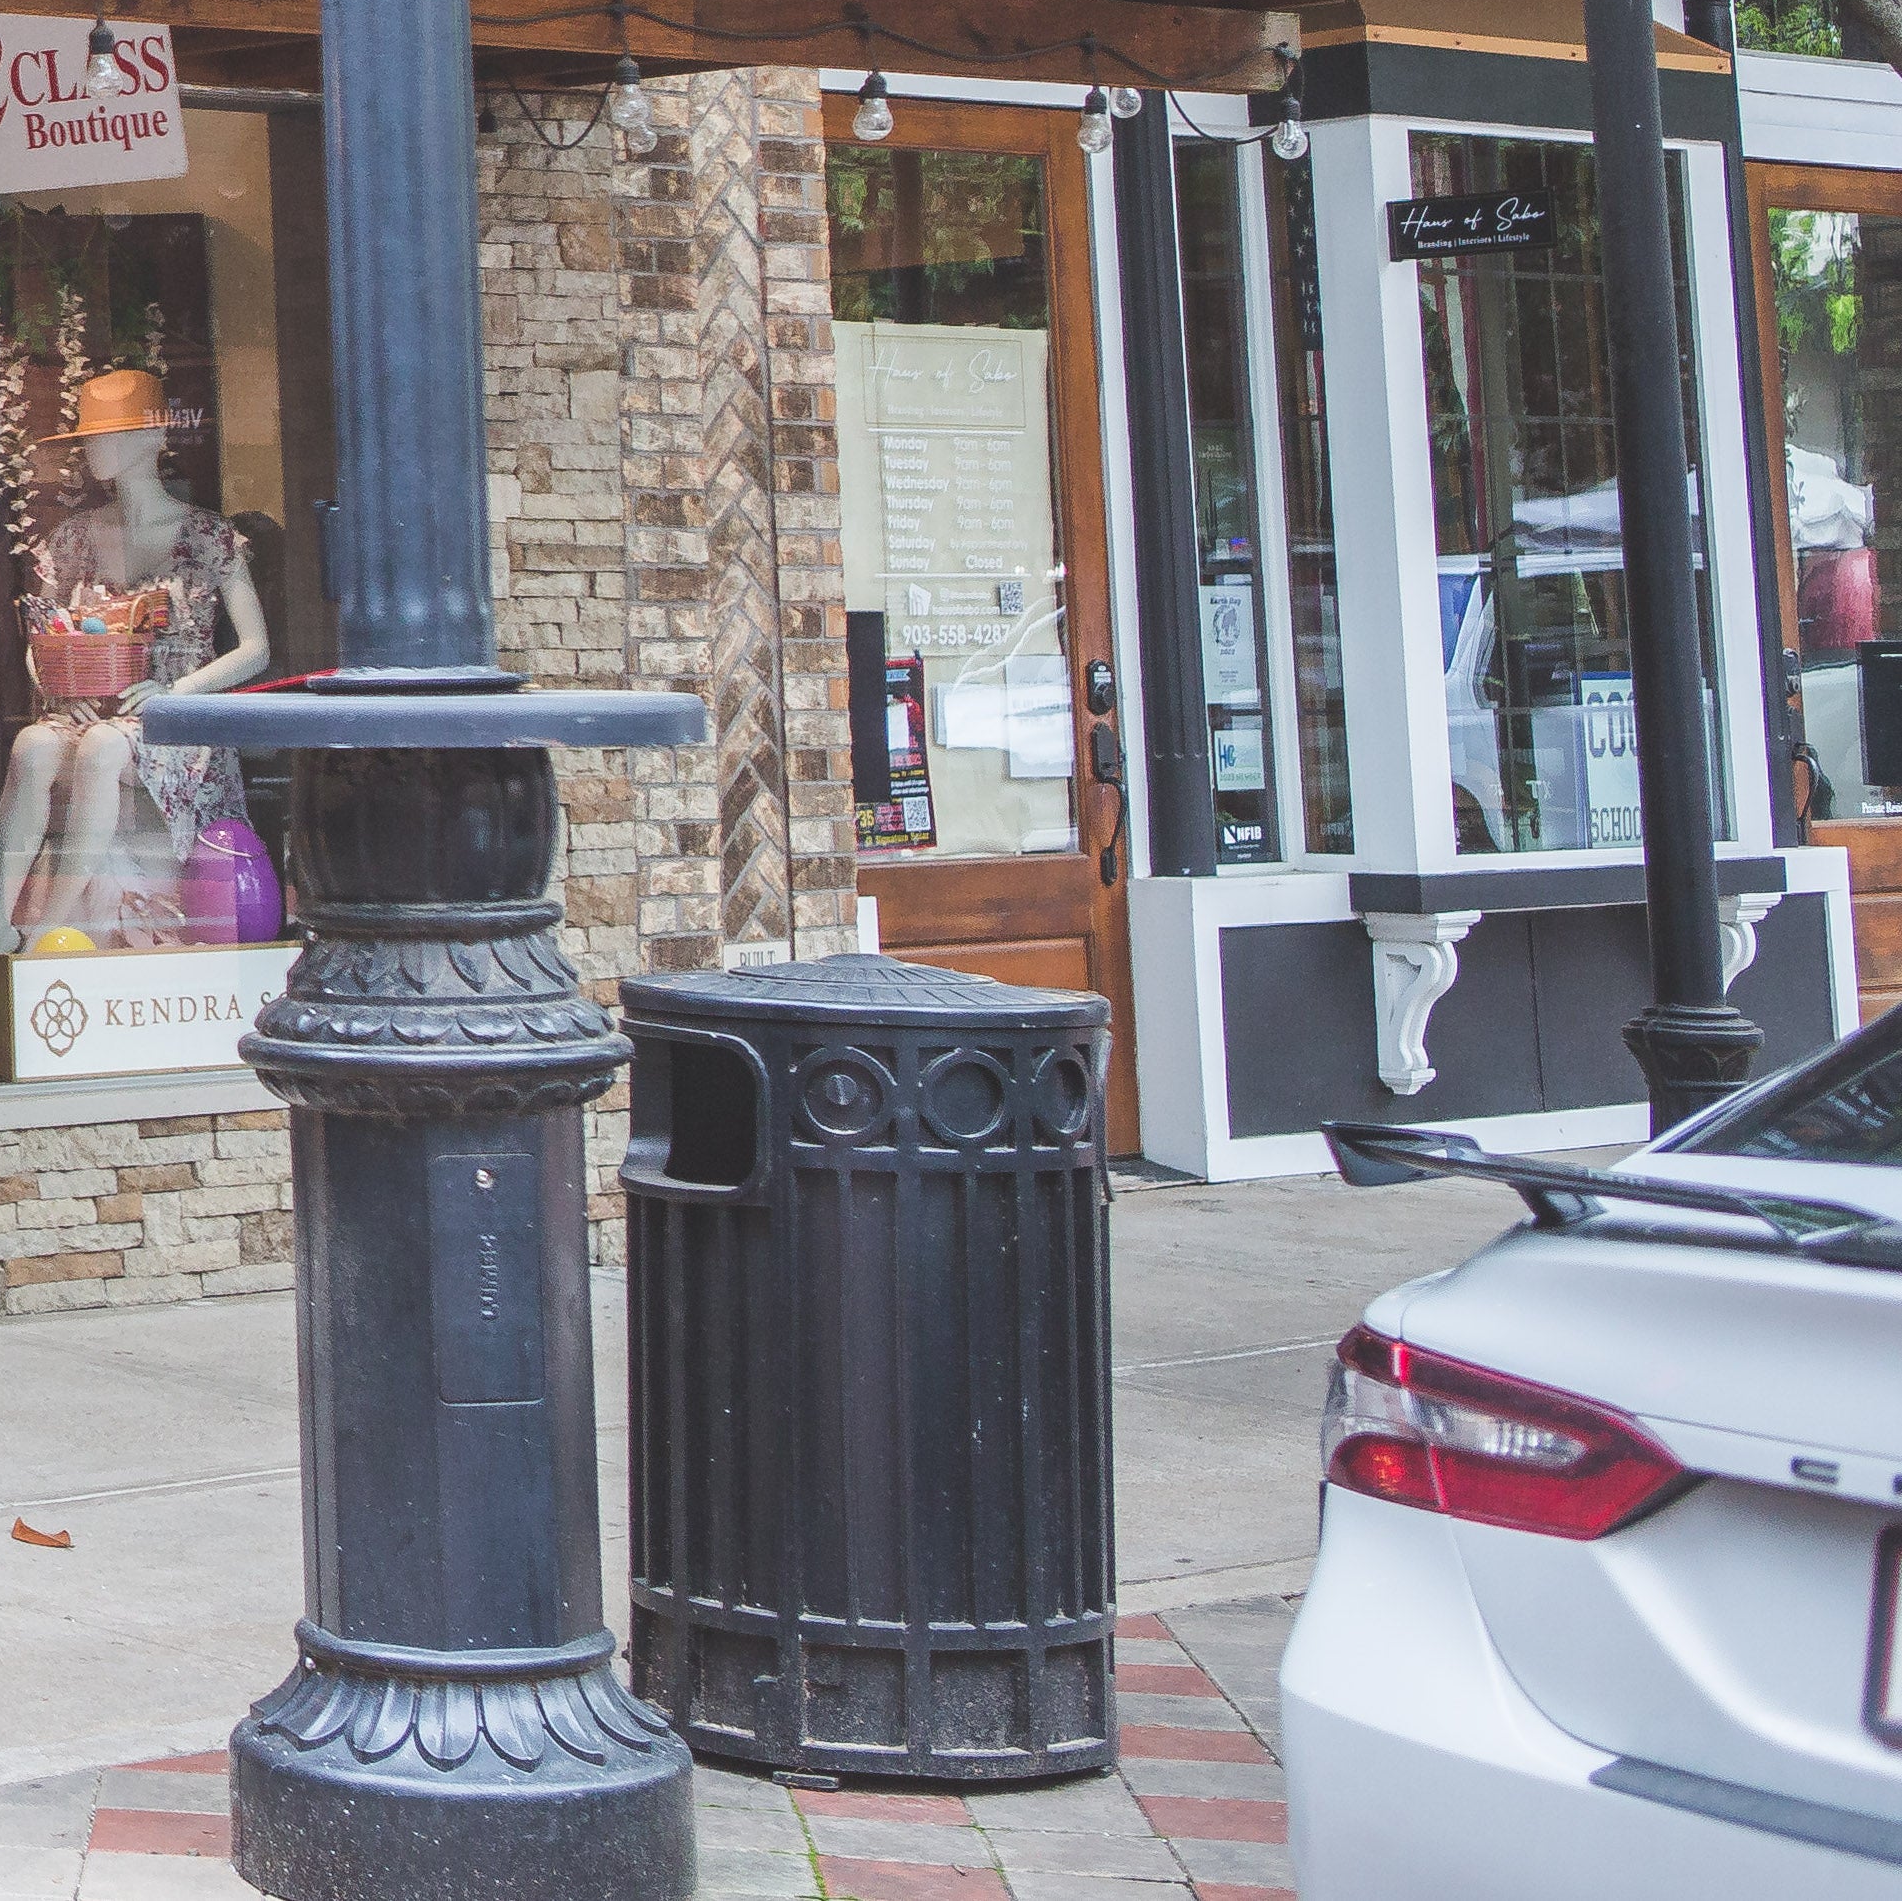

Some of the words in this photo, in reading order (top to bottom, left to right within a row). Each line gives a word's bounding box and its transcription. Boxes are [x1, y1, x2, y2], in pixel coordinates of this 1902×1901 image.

[9, 35, 171, 107] CLSS
[26, 106, 169, 151] Boutique
[1400, 206, 1453, 239] Haus
[1463, 209, 1483, 230] of
[1497, 197, 1545, 231] Sabo
[884, 436, 928, 452] Monday
[884, 456, 929, 472] Tuesday
[885, 475, 949, 491] Wednesday
[887, 496, 934, 511] Thursday
[889, 535, 935, 551] Saturday
[890, 554, 930, 570] Sunday
[965, 554, 1003, 569] Closed
[902, 624, 1011, 645] 903-558-4287
[1237, 826, 1262, 841] NFIB
[104, 993, 244, 1028] KENDRA
